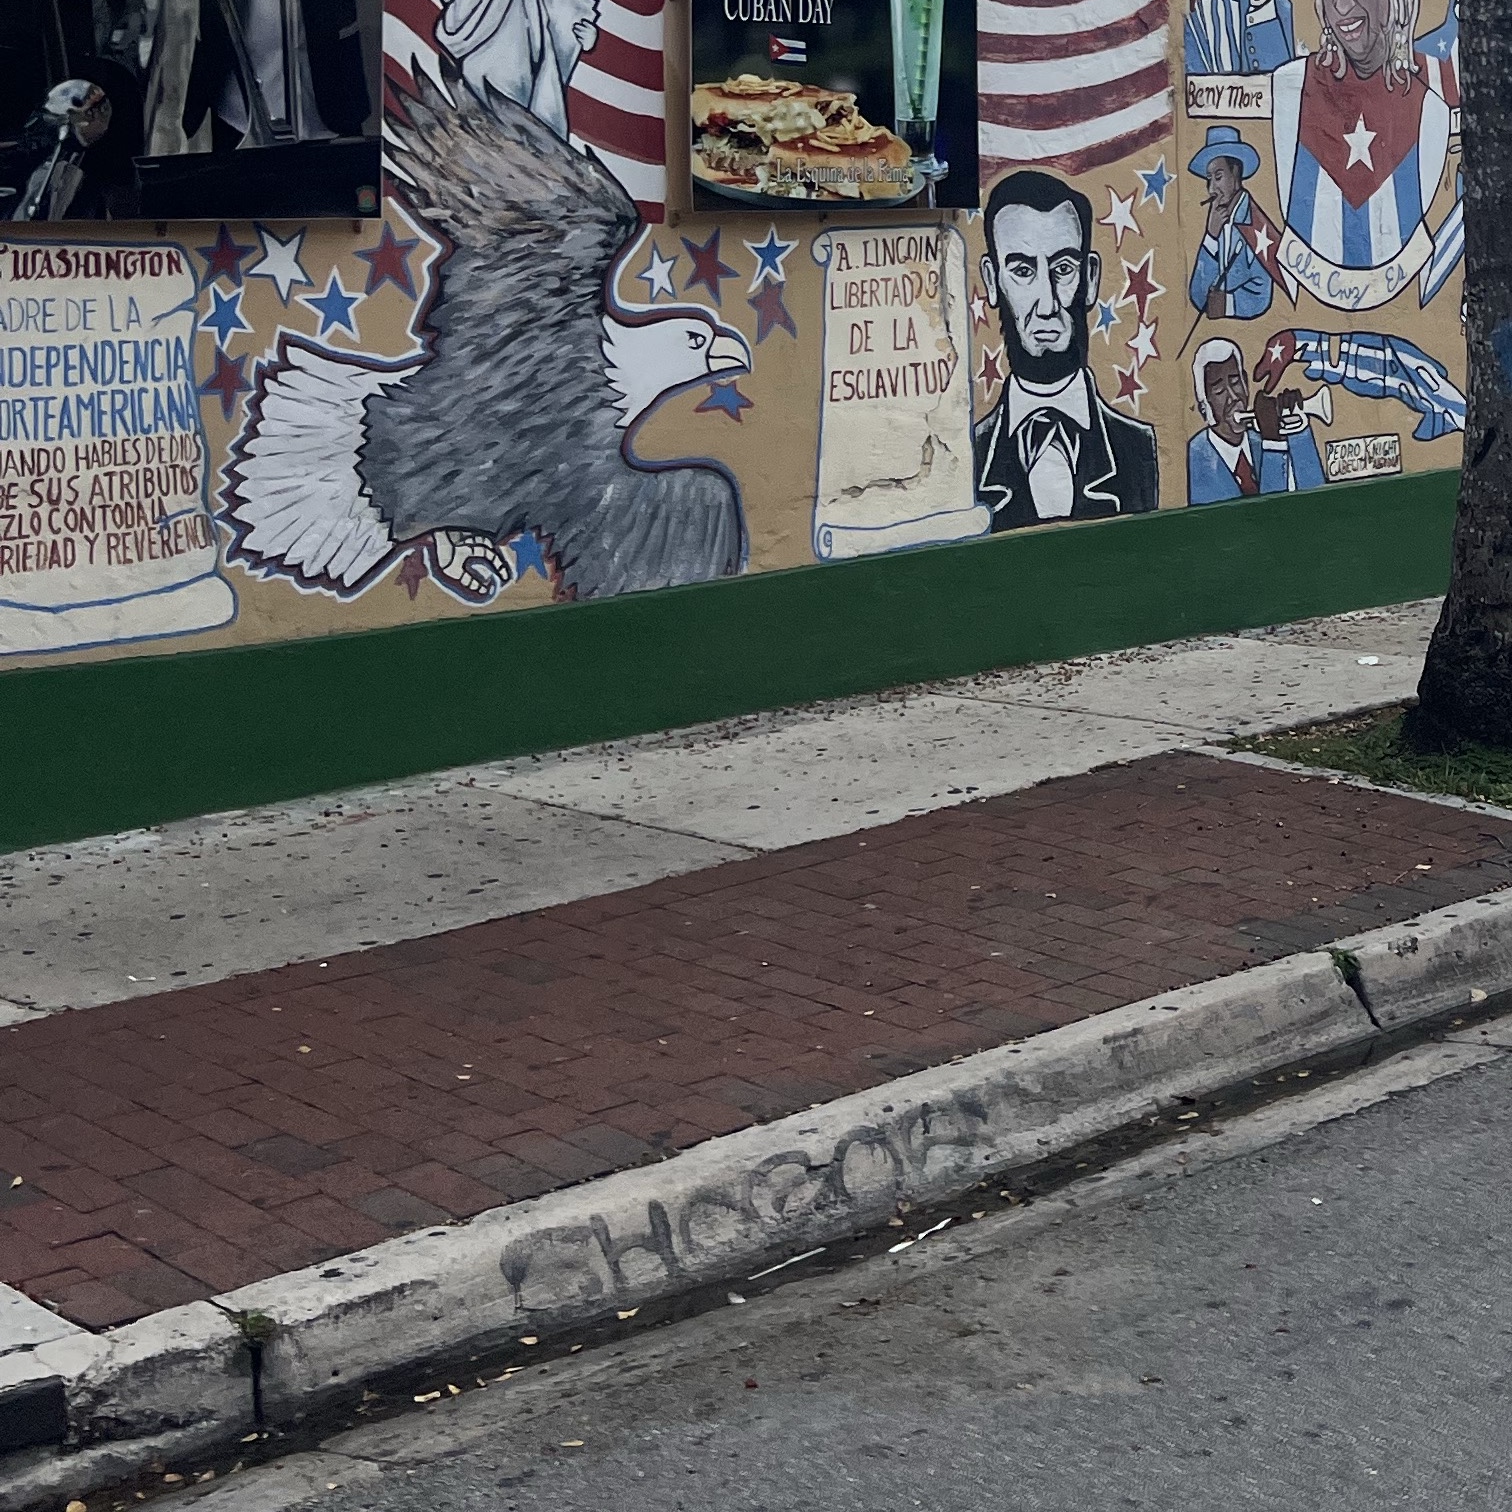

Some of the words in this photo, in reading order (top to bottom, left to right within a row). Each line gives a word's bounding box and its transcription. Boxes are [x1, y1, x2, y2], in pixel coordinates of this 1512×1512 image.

[776, 157, 792, 183] La
[797, 157, 844, 190] Esquina
[847, 157, 859, 183] de
[861, 157, 875, 182] la
[10, 248, 184, 282] WASHINGTON
[836, 243, 859, 272] A.
[66, 298, 97, 332] DE
[108, 295, 142, 333] LA
[850, 320, 874, 355] DE
[893, 316, 918, 351] LA
[0, 446, 66, 479] ANDO
[75, 438, 140, 472] HABLES
[1328, 443, 1361, 461] PEDRO
[28, 475, 80, 509] SUS
[89, 464, 199, 505] ATRIBUTOS
[0, 510, 41, 541] ZLO
[84, 533, 99, 565] Y
